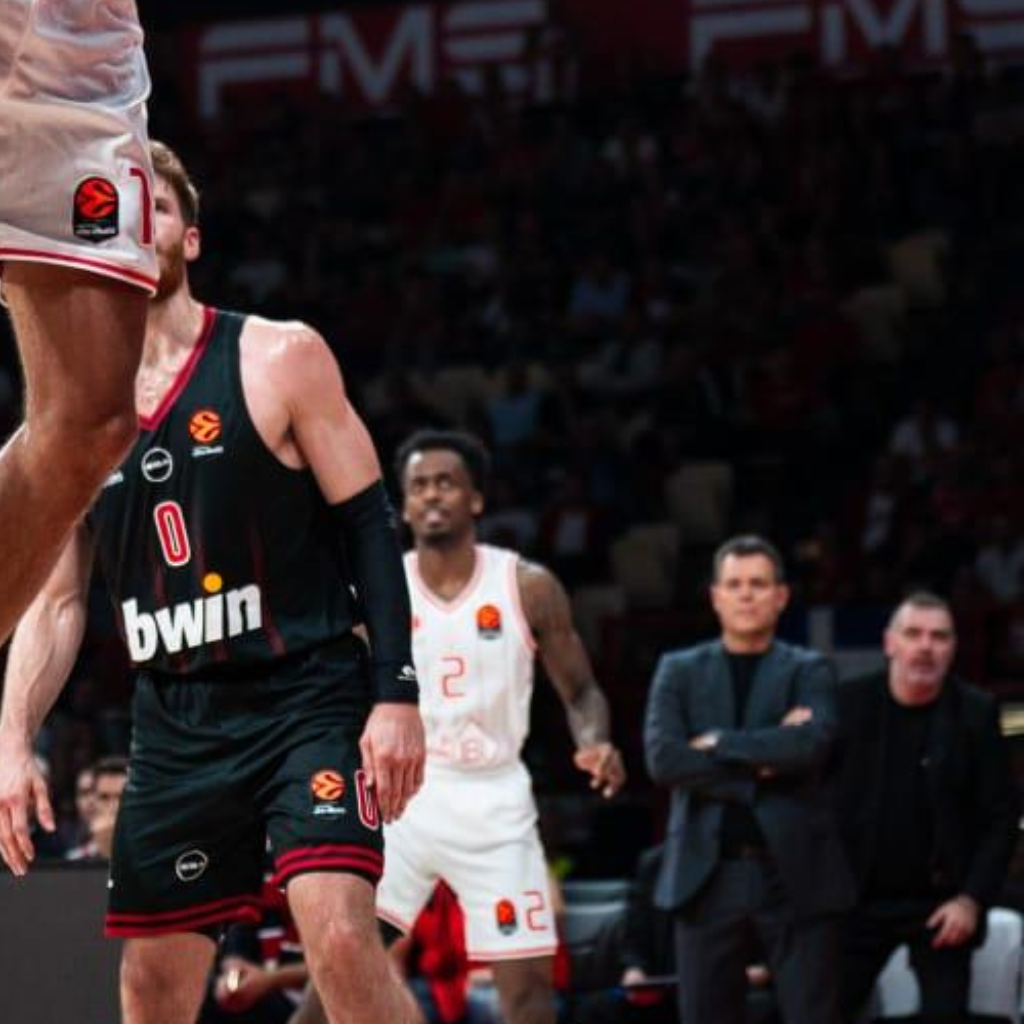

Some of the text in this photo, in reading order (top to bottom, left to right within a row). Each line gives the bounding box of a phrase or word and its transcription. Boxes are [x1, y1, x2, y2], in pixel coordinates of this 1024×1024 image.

[153, 499, 192, 568] 0
[121, 572, 262, 664] bwin
[440, 656, 466, 698] 2
[524, 890, 548, 931] 2
